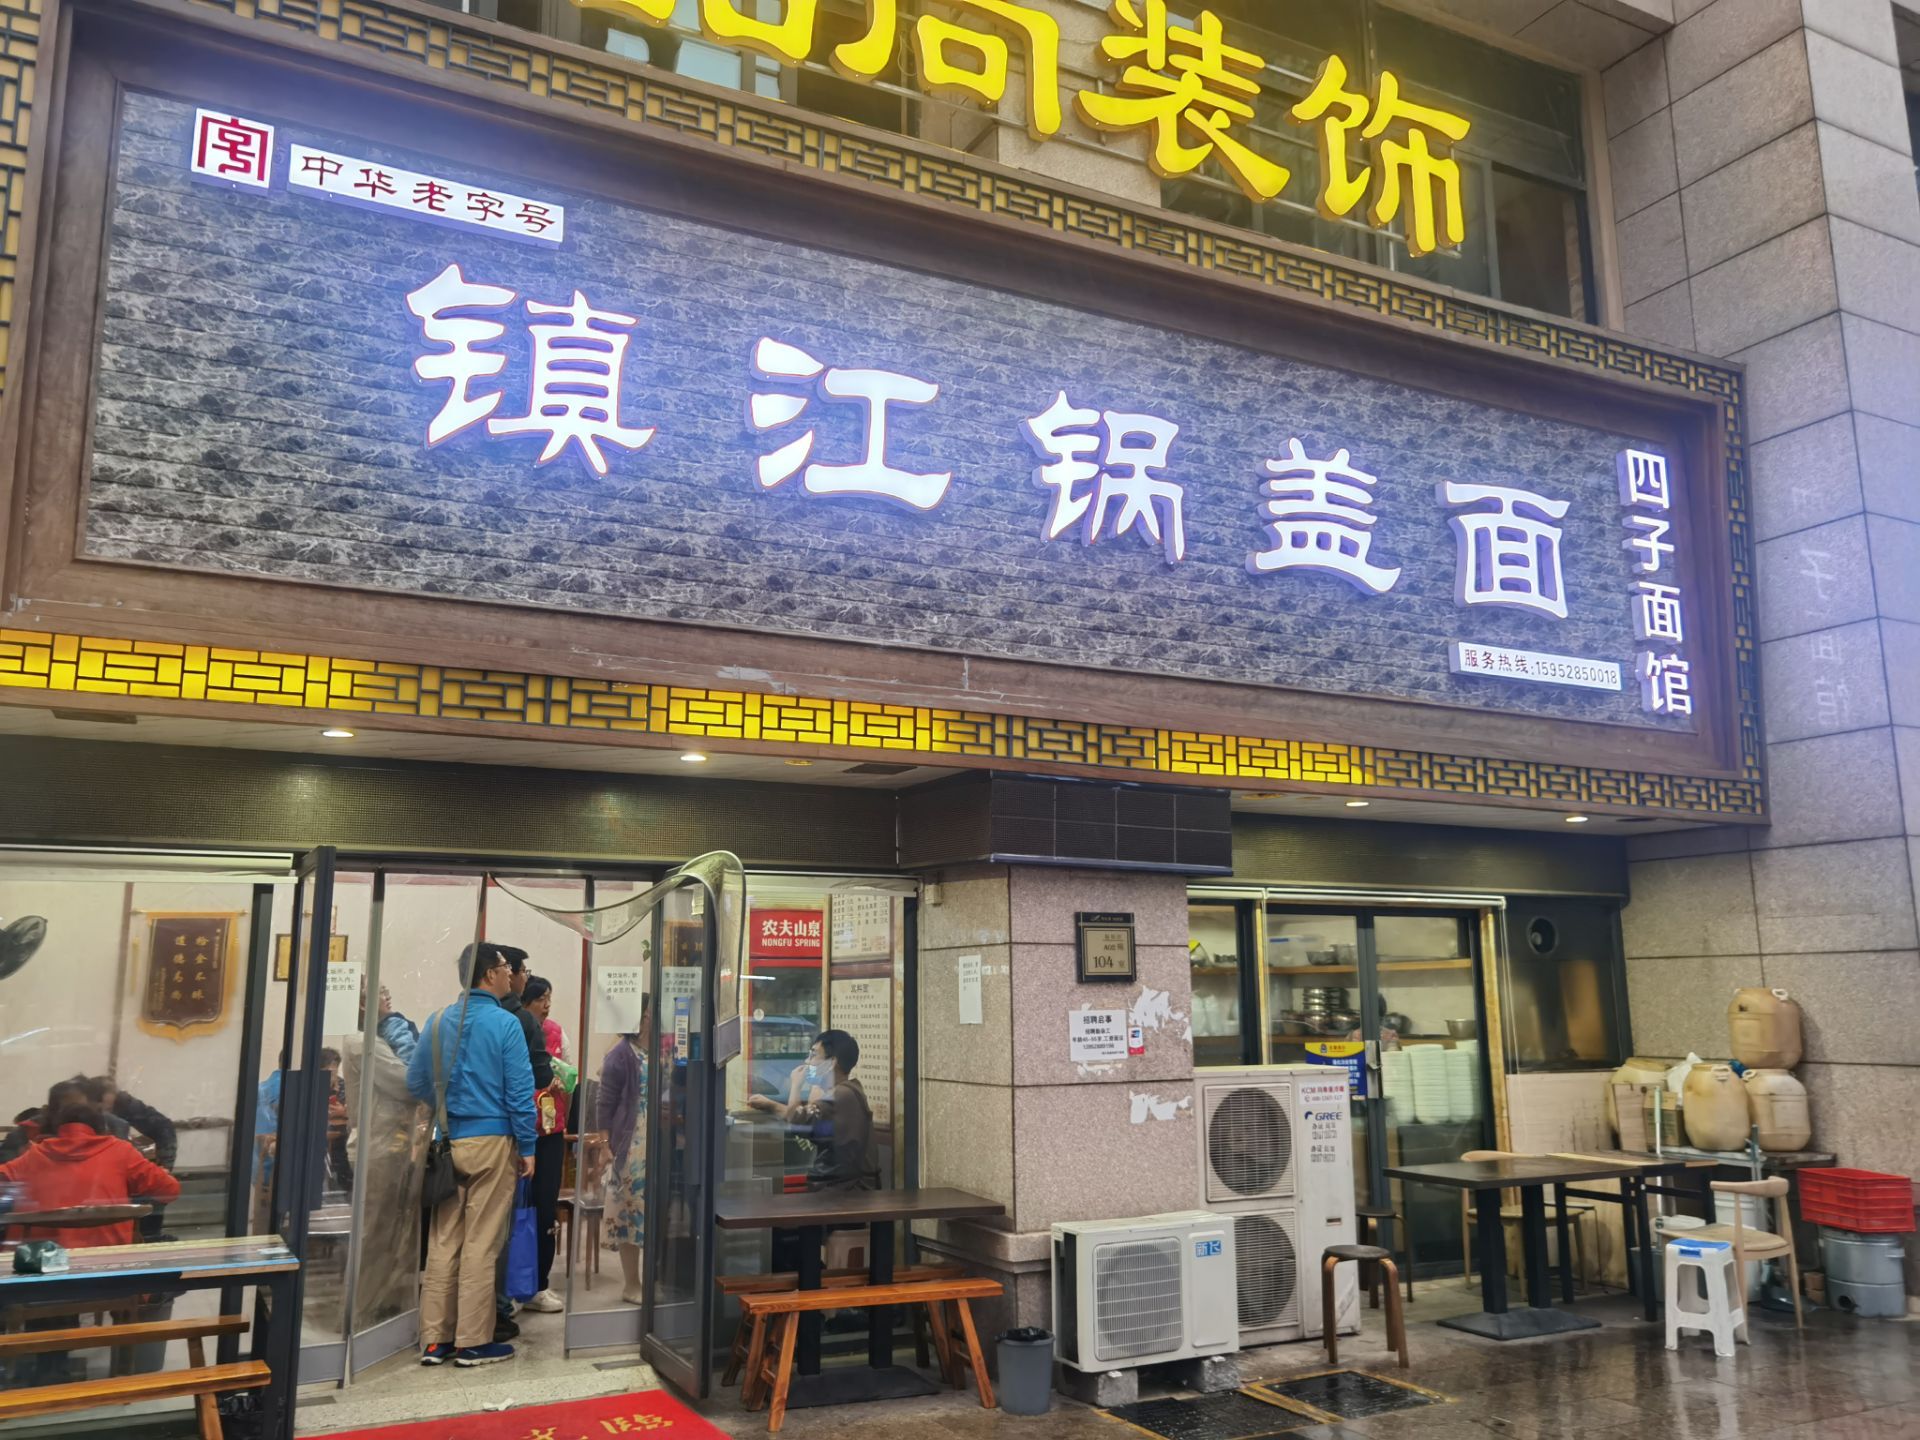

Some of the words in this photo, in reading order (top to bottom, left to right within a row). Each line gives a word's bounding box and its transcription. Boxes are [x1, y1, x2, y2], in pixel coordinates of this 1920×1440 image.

[568, 0, 1472, 256] 尚装饰
[301, 155, 555, 233] 中华老字号
[405, 263, 1571, 619] 镇江锅盖面
[1625, 449, 1692, 715] 四子面馆
[761, 938, 792, 947] NONGFU
[795, 938, 820, 947] SPRING
[762, 919, 821, 937] 农夫山泉
[1093, 955, 1114, 969] 104
[1315, 1112, 1343, 1121] GREE
